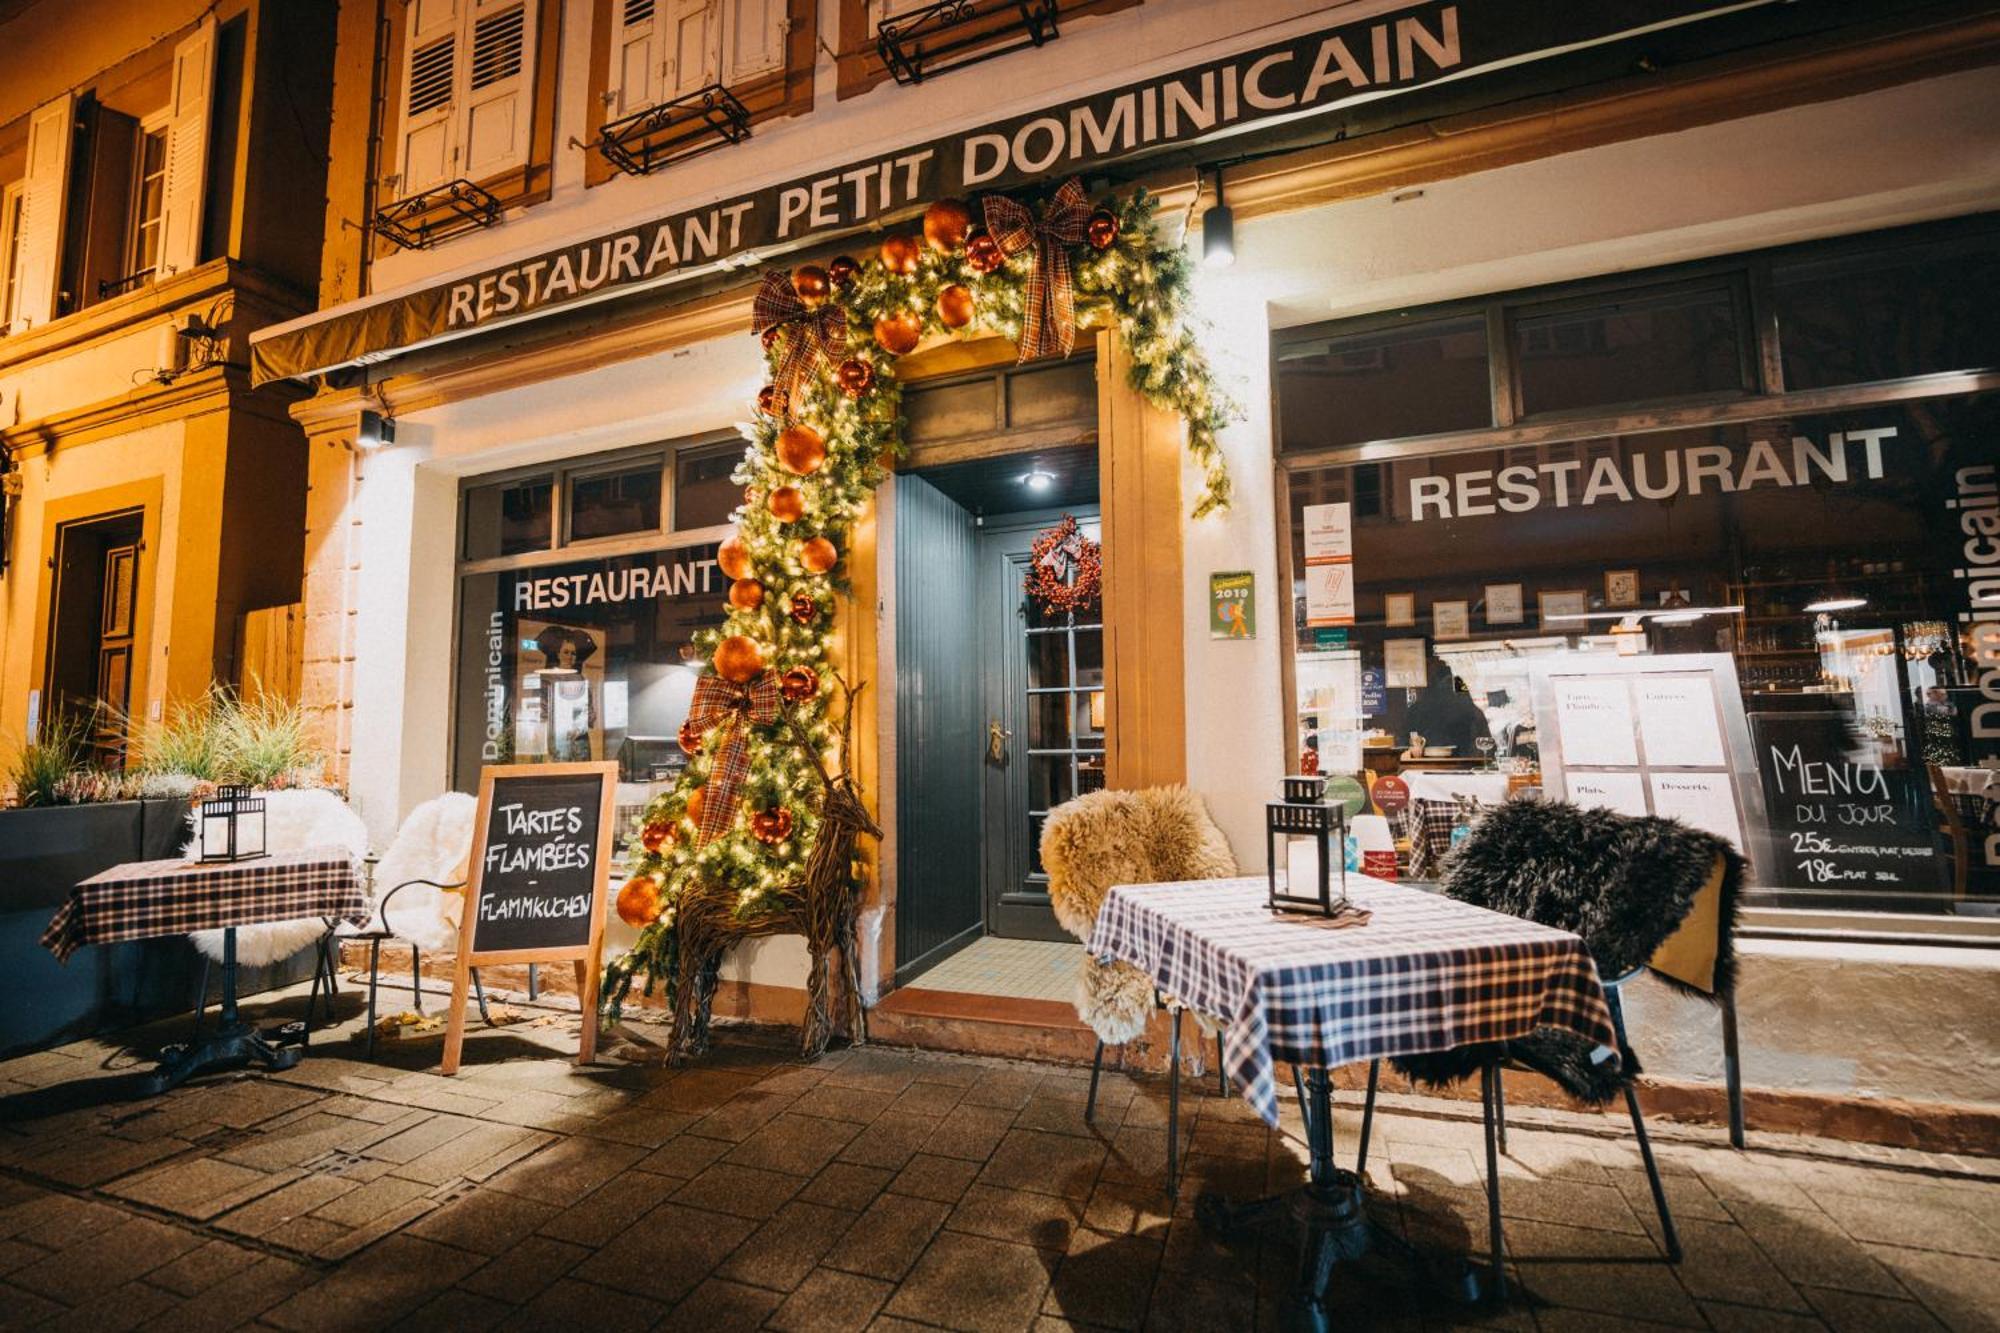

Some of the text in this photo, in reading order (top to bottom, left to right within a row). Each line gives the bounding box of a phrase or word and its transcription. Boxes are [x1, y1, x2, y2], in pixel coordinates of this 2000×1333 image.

[447, 6, 1462, 326] RESTAURANT PETIT DOMINICAIN
[1409, 426, 1898, 522] RESTAURANT
[514, 558, 718, 612] RESTAURANT
[482, 610, 505, 761] Dominicain
[1770, 744, 1890, 800] MENU
[499, 803, 582, 834] TARTES
[1796, 803, 1897, 825] DU JOUR
[486, 834, 590, 873] FLAMBÉES
[480, 892, 592, 921] FLAMMKUCHEN
